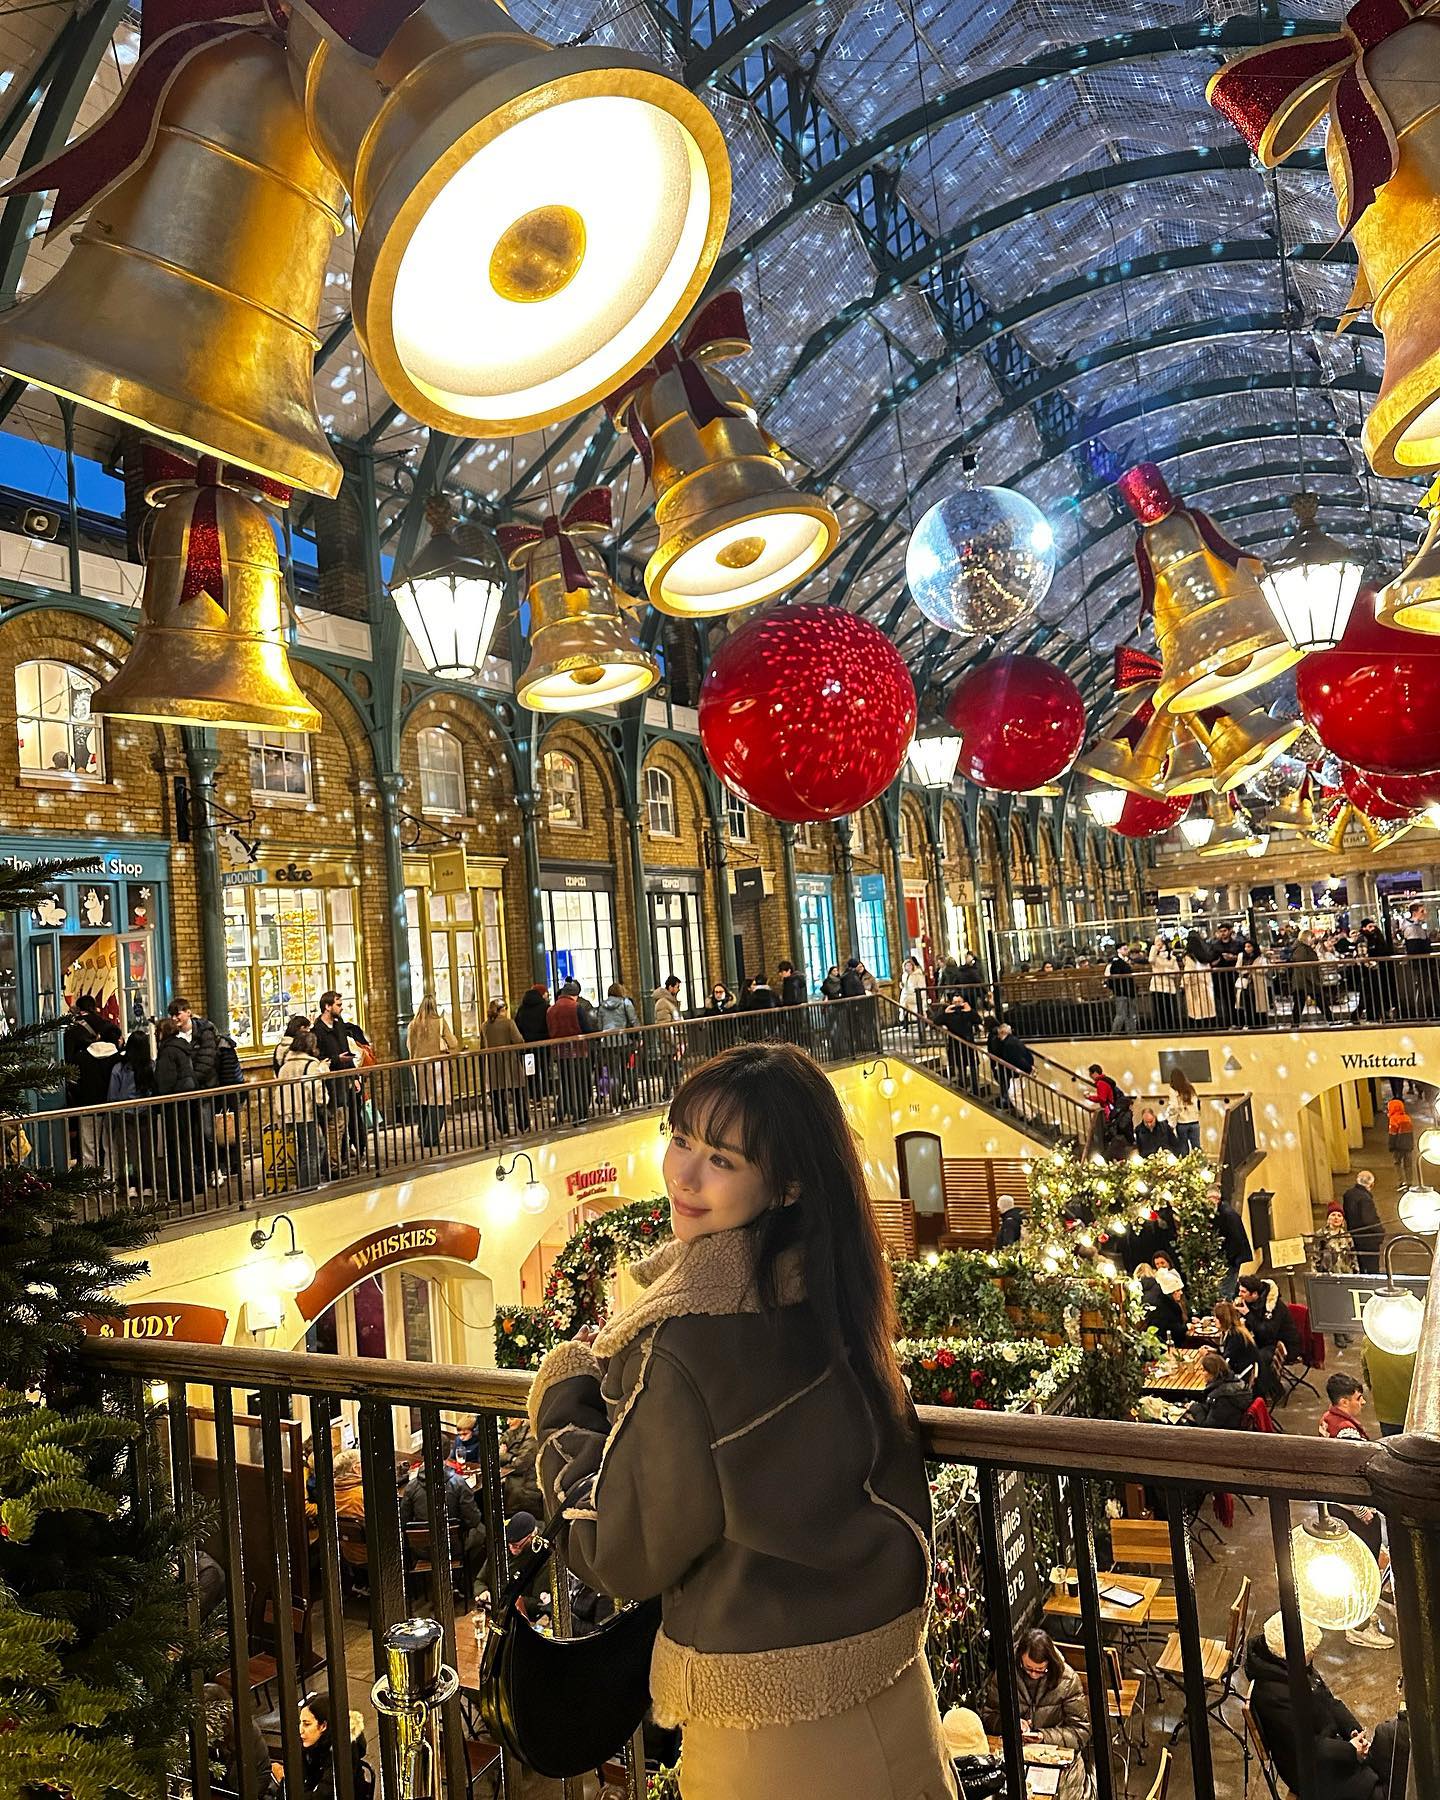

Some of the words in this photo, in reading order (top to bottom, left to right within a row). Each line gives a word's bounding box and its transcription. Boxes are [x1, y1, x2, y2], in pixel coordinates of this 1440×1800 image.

[110, 858, 143, 877] Shop
[225, 869, 258, 885] MOOMIN
[1340, 1052, 1417, 1069] Whittard
[351, 1228, 437, 1270] WHISKIES
[123, 1315, 182, 1339] JUDY
